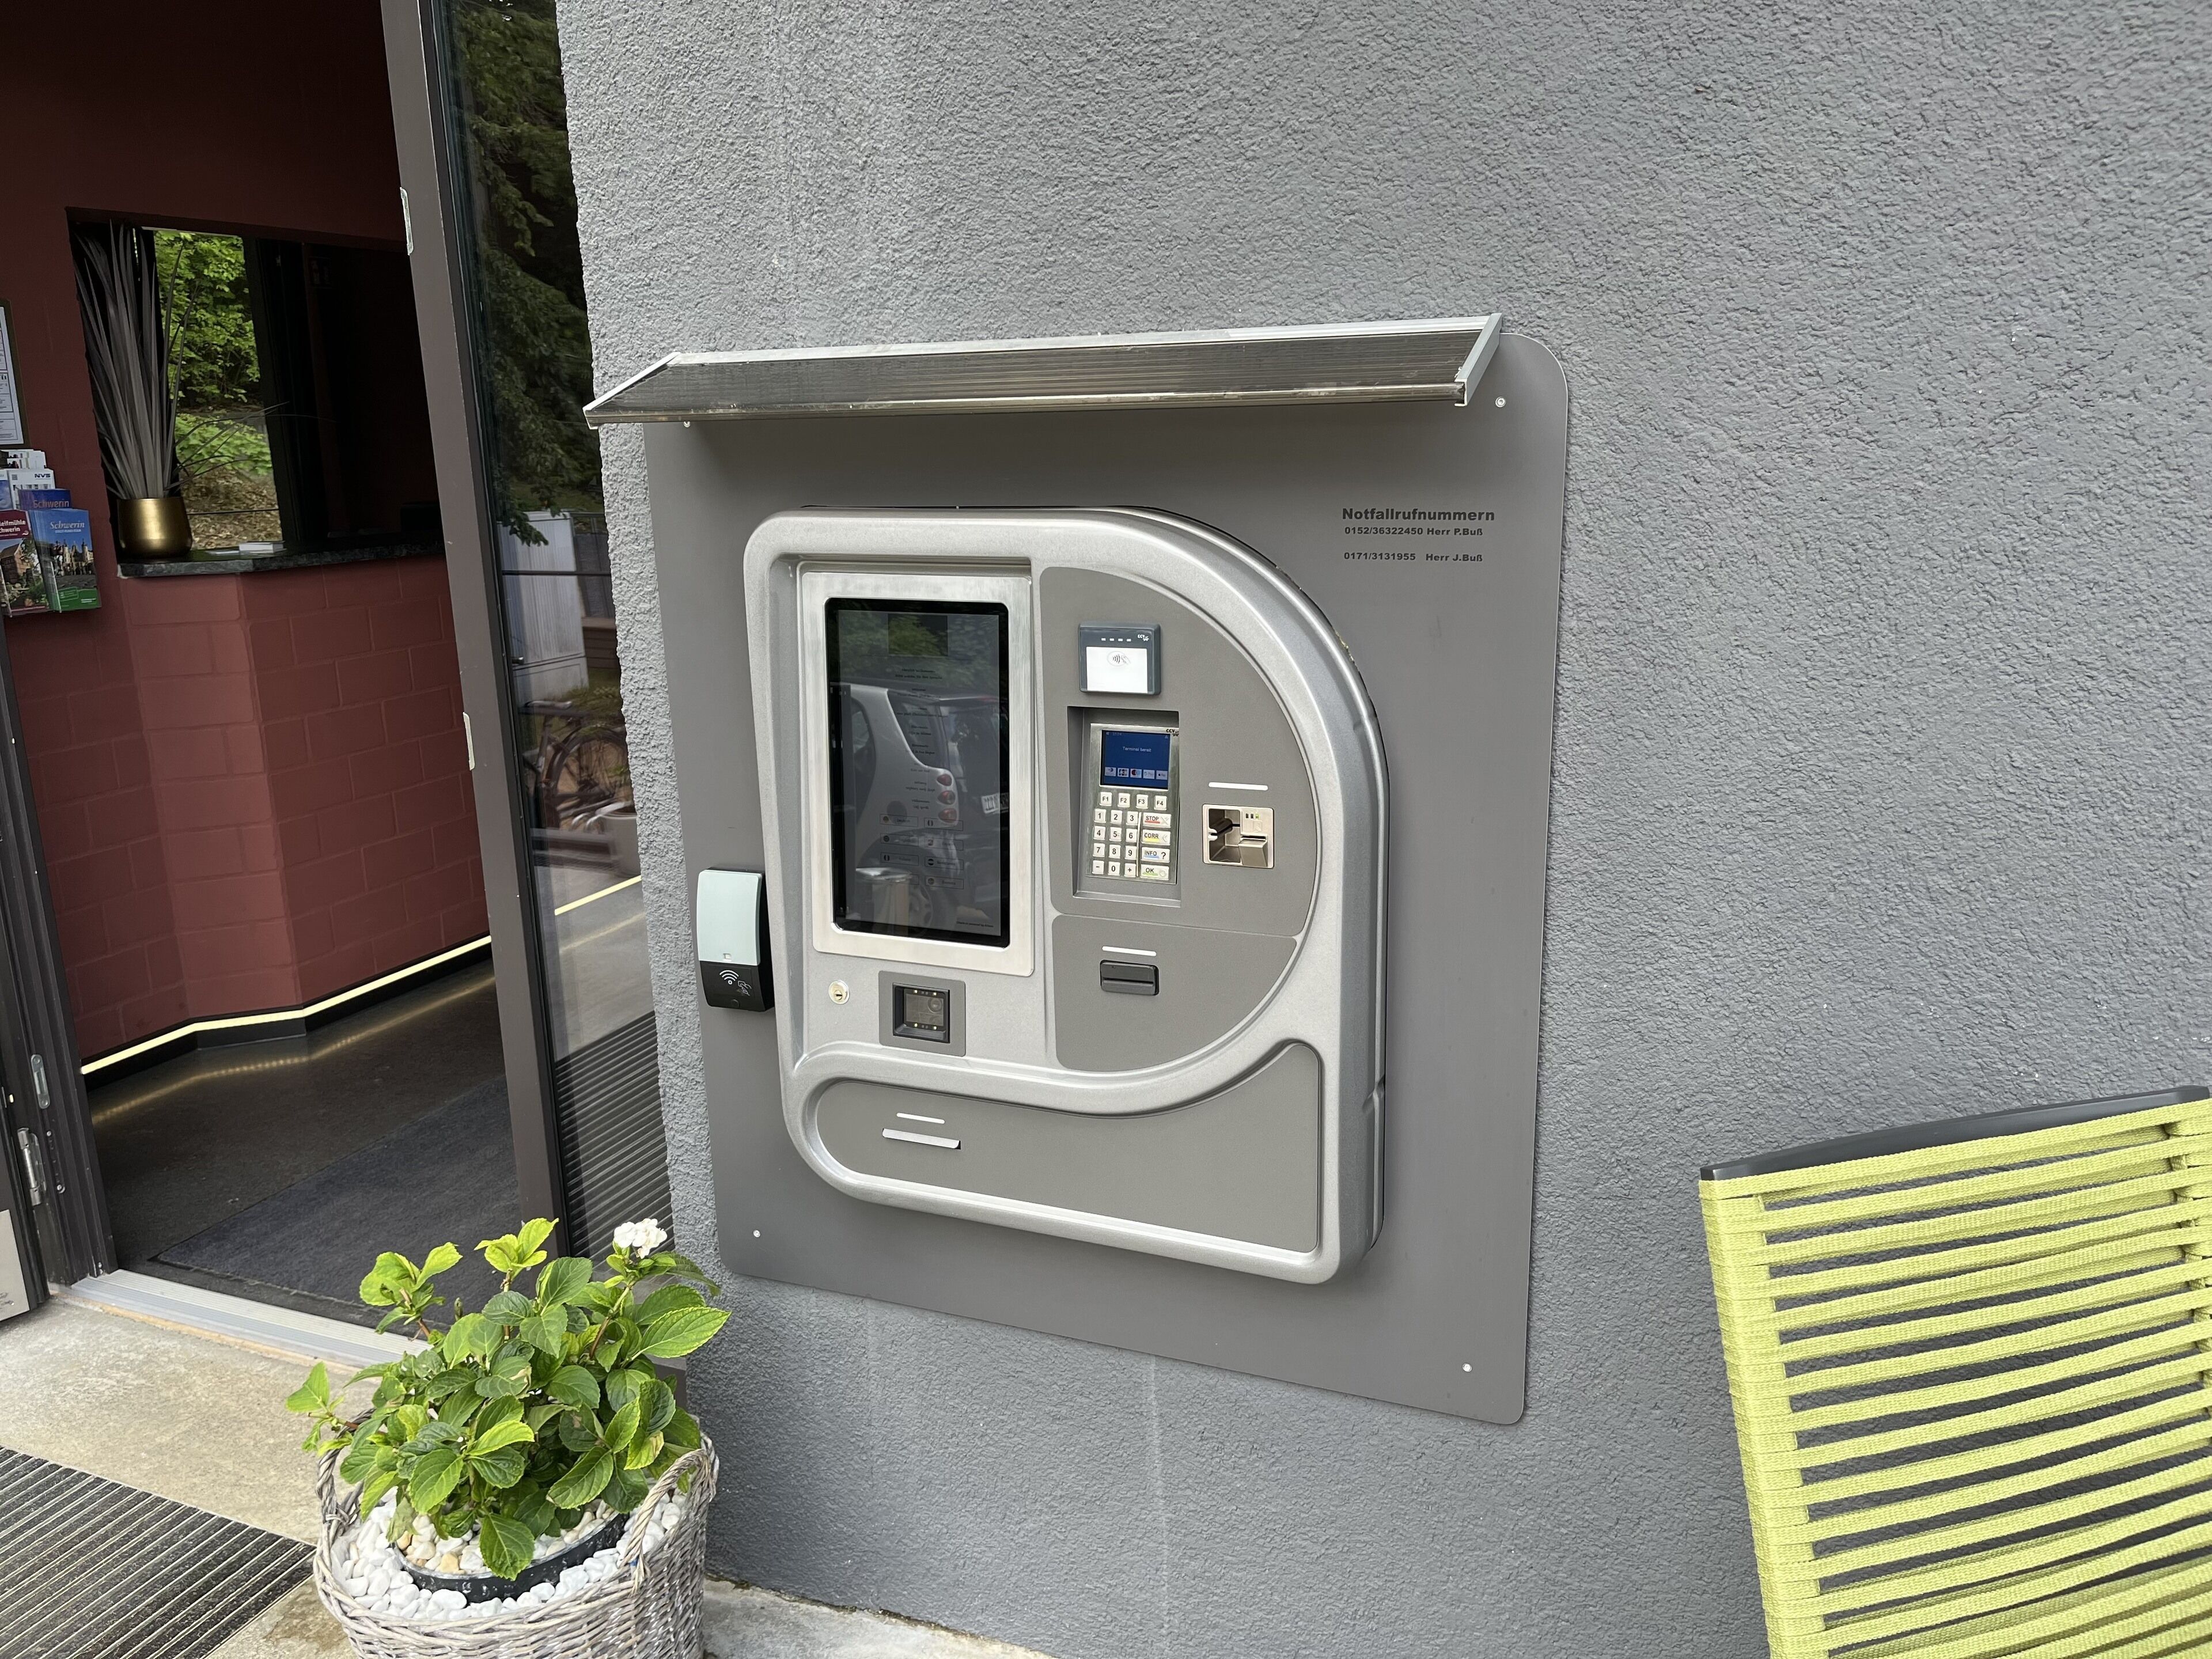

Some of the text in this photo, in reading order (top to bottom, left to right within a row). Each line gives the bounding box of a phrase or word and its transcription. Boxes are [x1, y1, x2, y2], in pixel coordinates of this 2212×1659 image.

[33, 499, 70, 508] Schwerin
[1342, 508, 1495, 521] Notfallrufnummern
[50, 520, 85, 529] Schwerin
[1344, 527, 1423, 535] 0152/36322450
[1344, 552, 1483, 562] 0171/3131955 Herr J.Buß
